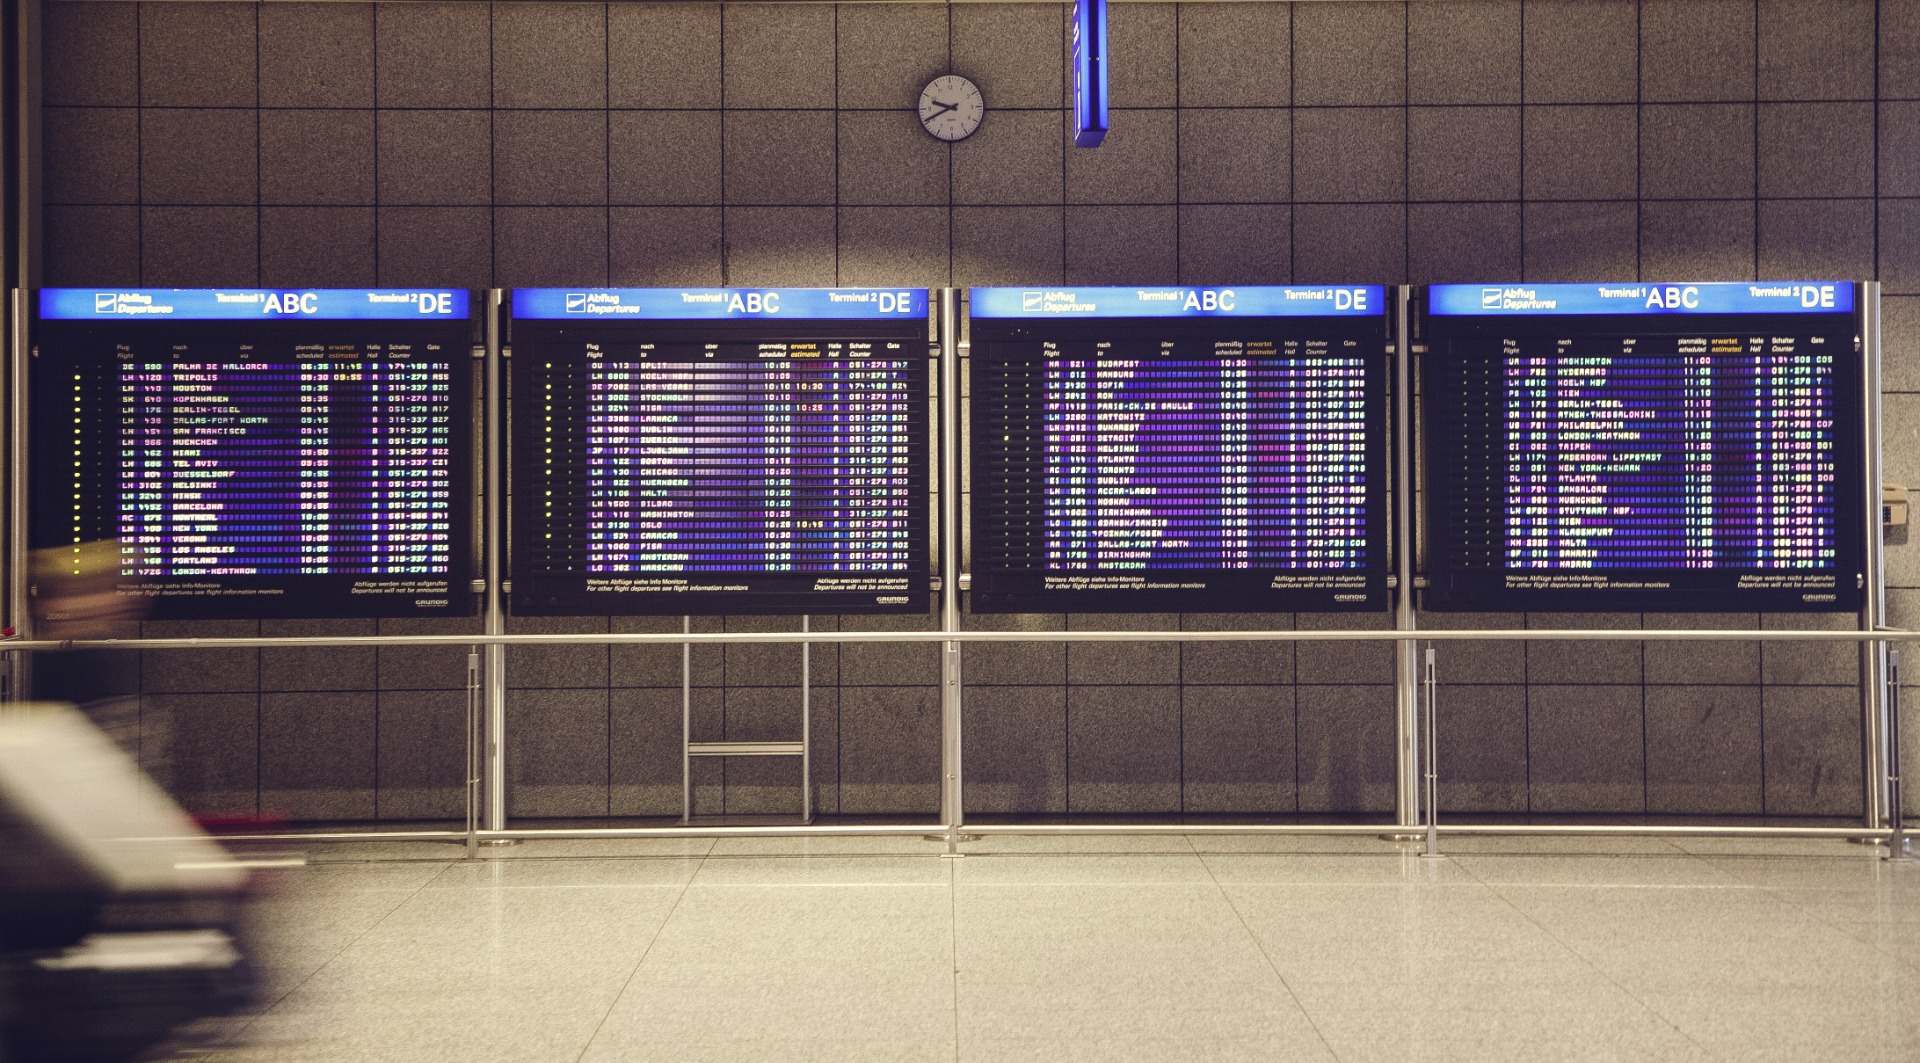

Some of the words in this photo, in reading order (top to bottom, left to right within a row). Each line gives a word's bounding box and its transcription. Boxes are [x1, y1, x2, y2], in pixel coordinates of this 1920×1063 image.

[118, 294, 152, 304] Abflug
[587, 294, 620, 304] Abflug
[829, 292, 869, 302] Terminal
[870, 292, 878, 302] 2
[879, 292, 910, 312] DE
[1044, 292, 1076, 302] Abflug
[1138, 291, 1178, 300] Terminal
[1183, 290, 1234, 311] ABC
[1284, 290, 1325, 300] Terminal
[1326, 290, 1333, 300] 2
[1336, 290, 1367, 310] DE
[1503, 288, 1535, 300] Abflug
[1598, 288, 1638, 298] Terminal
[1646, 287, 1699, 308] ABC
[1750, 286, 1791, 297] Terminal
[1792, 286, 1800, 296] 2
[1802, 286, 1835, 308] DE
[118, 304, 174, 315] Departures
[215, 294, 258, 302] Terminal
[264, 293, 318, 314] ABC
[367, 294, 409, 302] Terminal
[410, 294, 418, 302] 2
[419, 293, 452, 314] DE
[587, 304, 640, 314] Departures
[682, 293, 722, 303] Terminal
[728, 292, 780, 314] ABC
[1044, 302, 1096, 313] Departures
[1503, 299, 1556, 310] Departures
